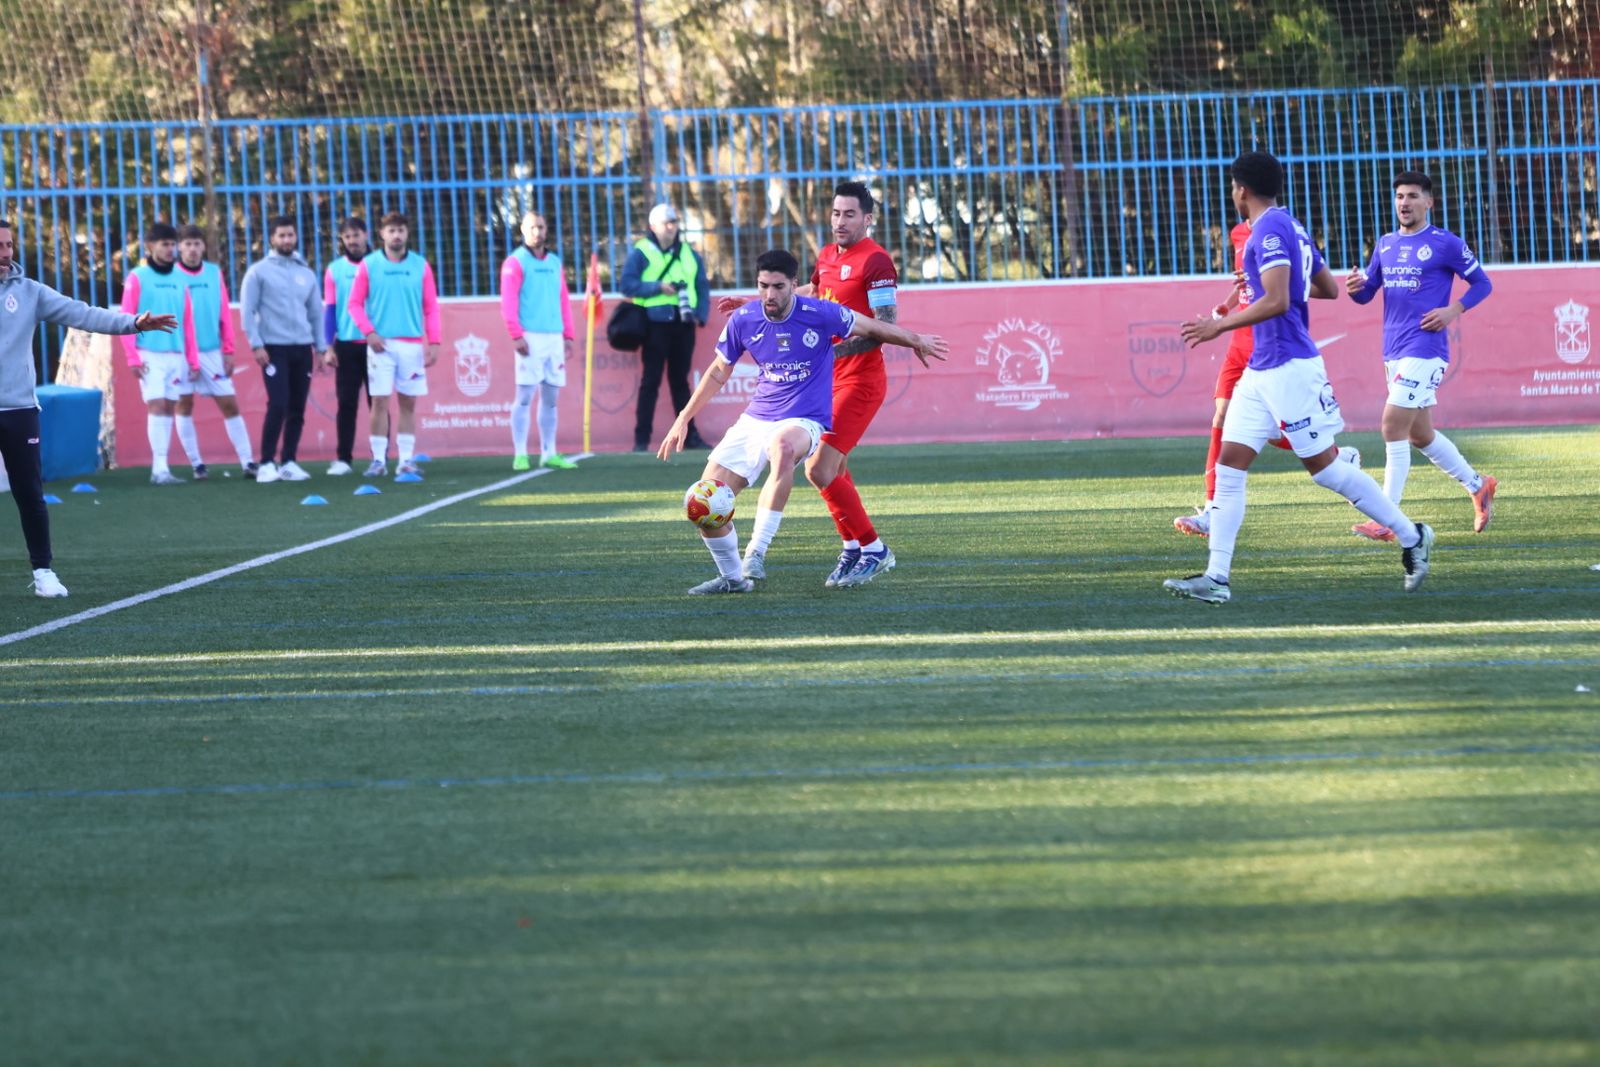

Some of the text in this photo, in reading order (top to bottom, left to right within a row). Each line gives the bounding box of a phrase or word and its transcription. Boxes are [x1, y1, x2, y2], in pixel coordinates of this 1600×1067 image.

[1520, 384, 1548, 397] Santa
[1550, 383, 1579, 395] Marta
[1581, 382, 1593, 394] de
